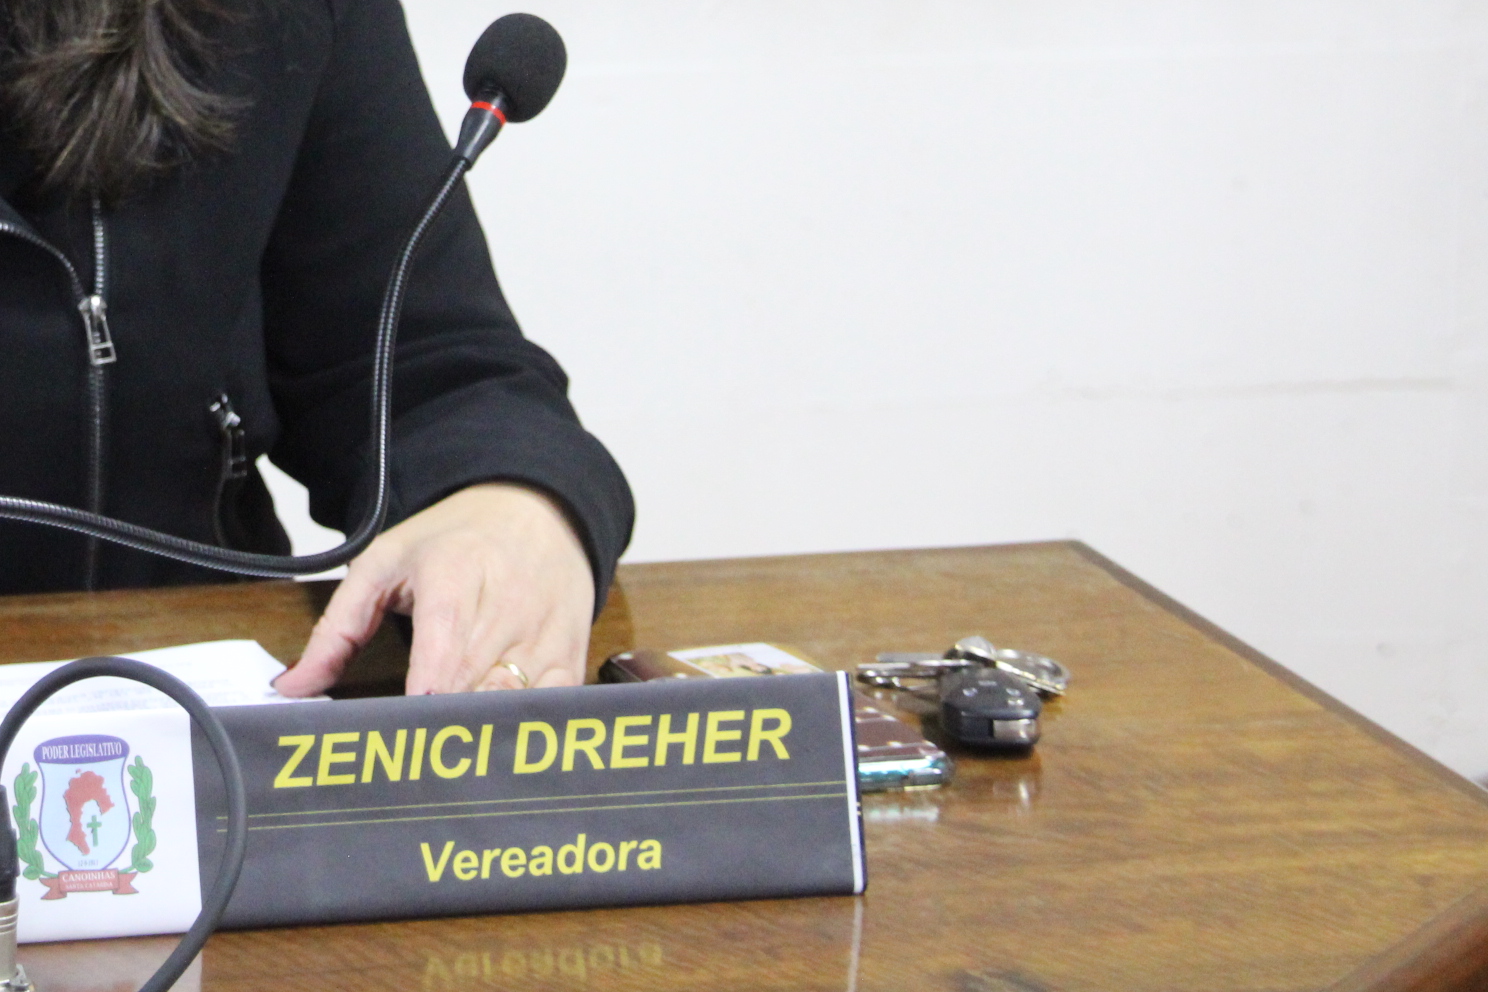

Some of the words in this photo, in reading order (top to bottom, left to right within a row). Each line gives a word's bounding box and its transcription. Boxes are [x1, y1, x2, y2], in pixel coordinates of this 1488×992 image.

[41, 745, 69, 760] PODER
[69, 741, 123, 758] LEGISLATIVO
[274, 725, 493, 788] ZENICI
[514, 709, 791, 773] DREHER
[421, 834, 661, 881] Vereadora
[62, 871, 116, 882] CANOINHAS
